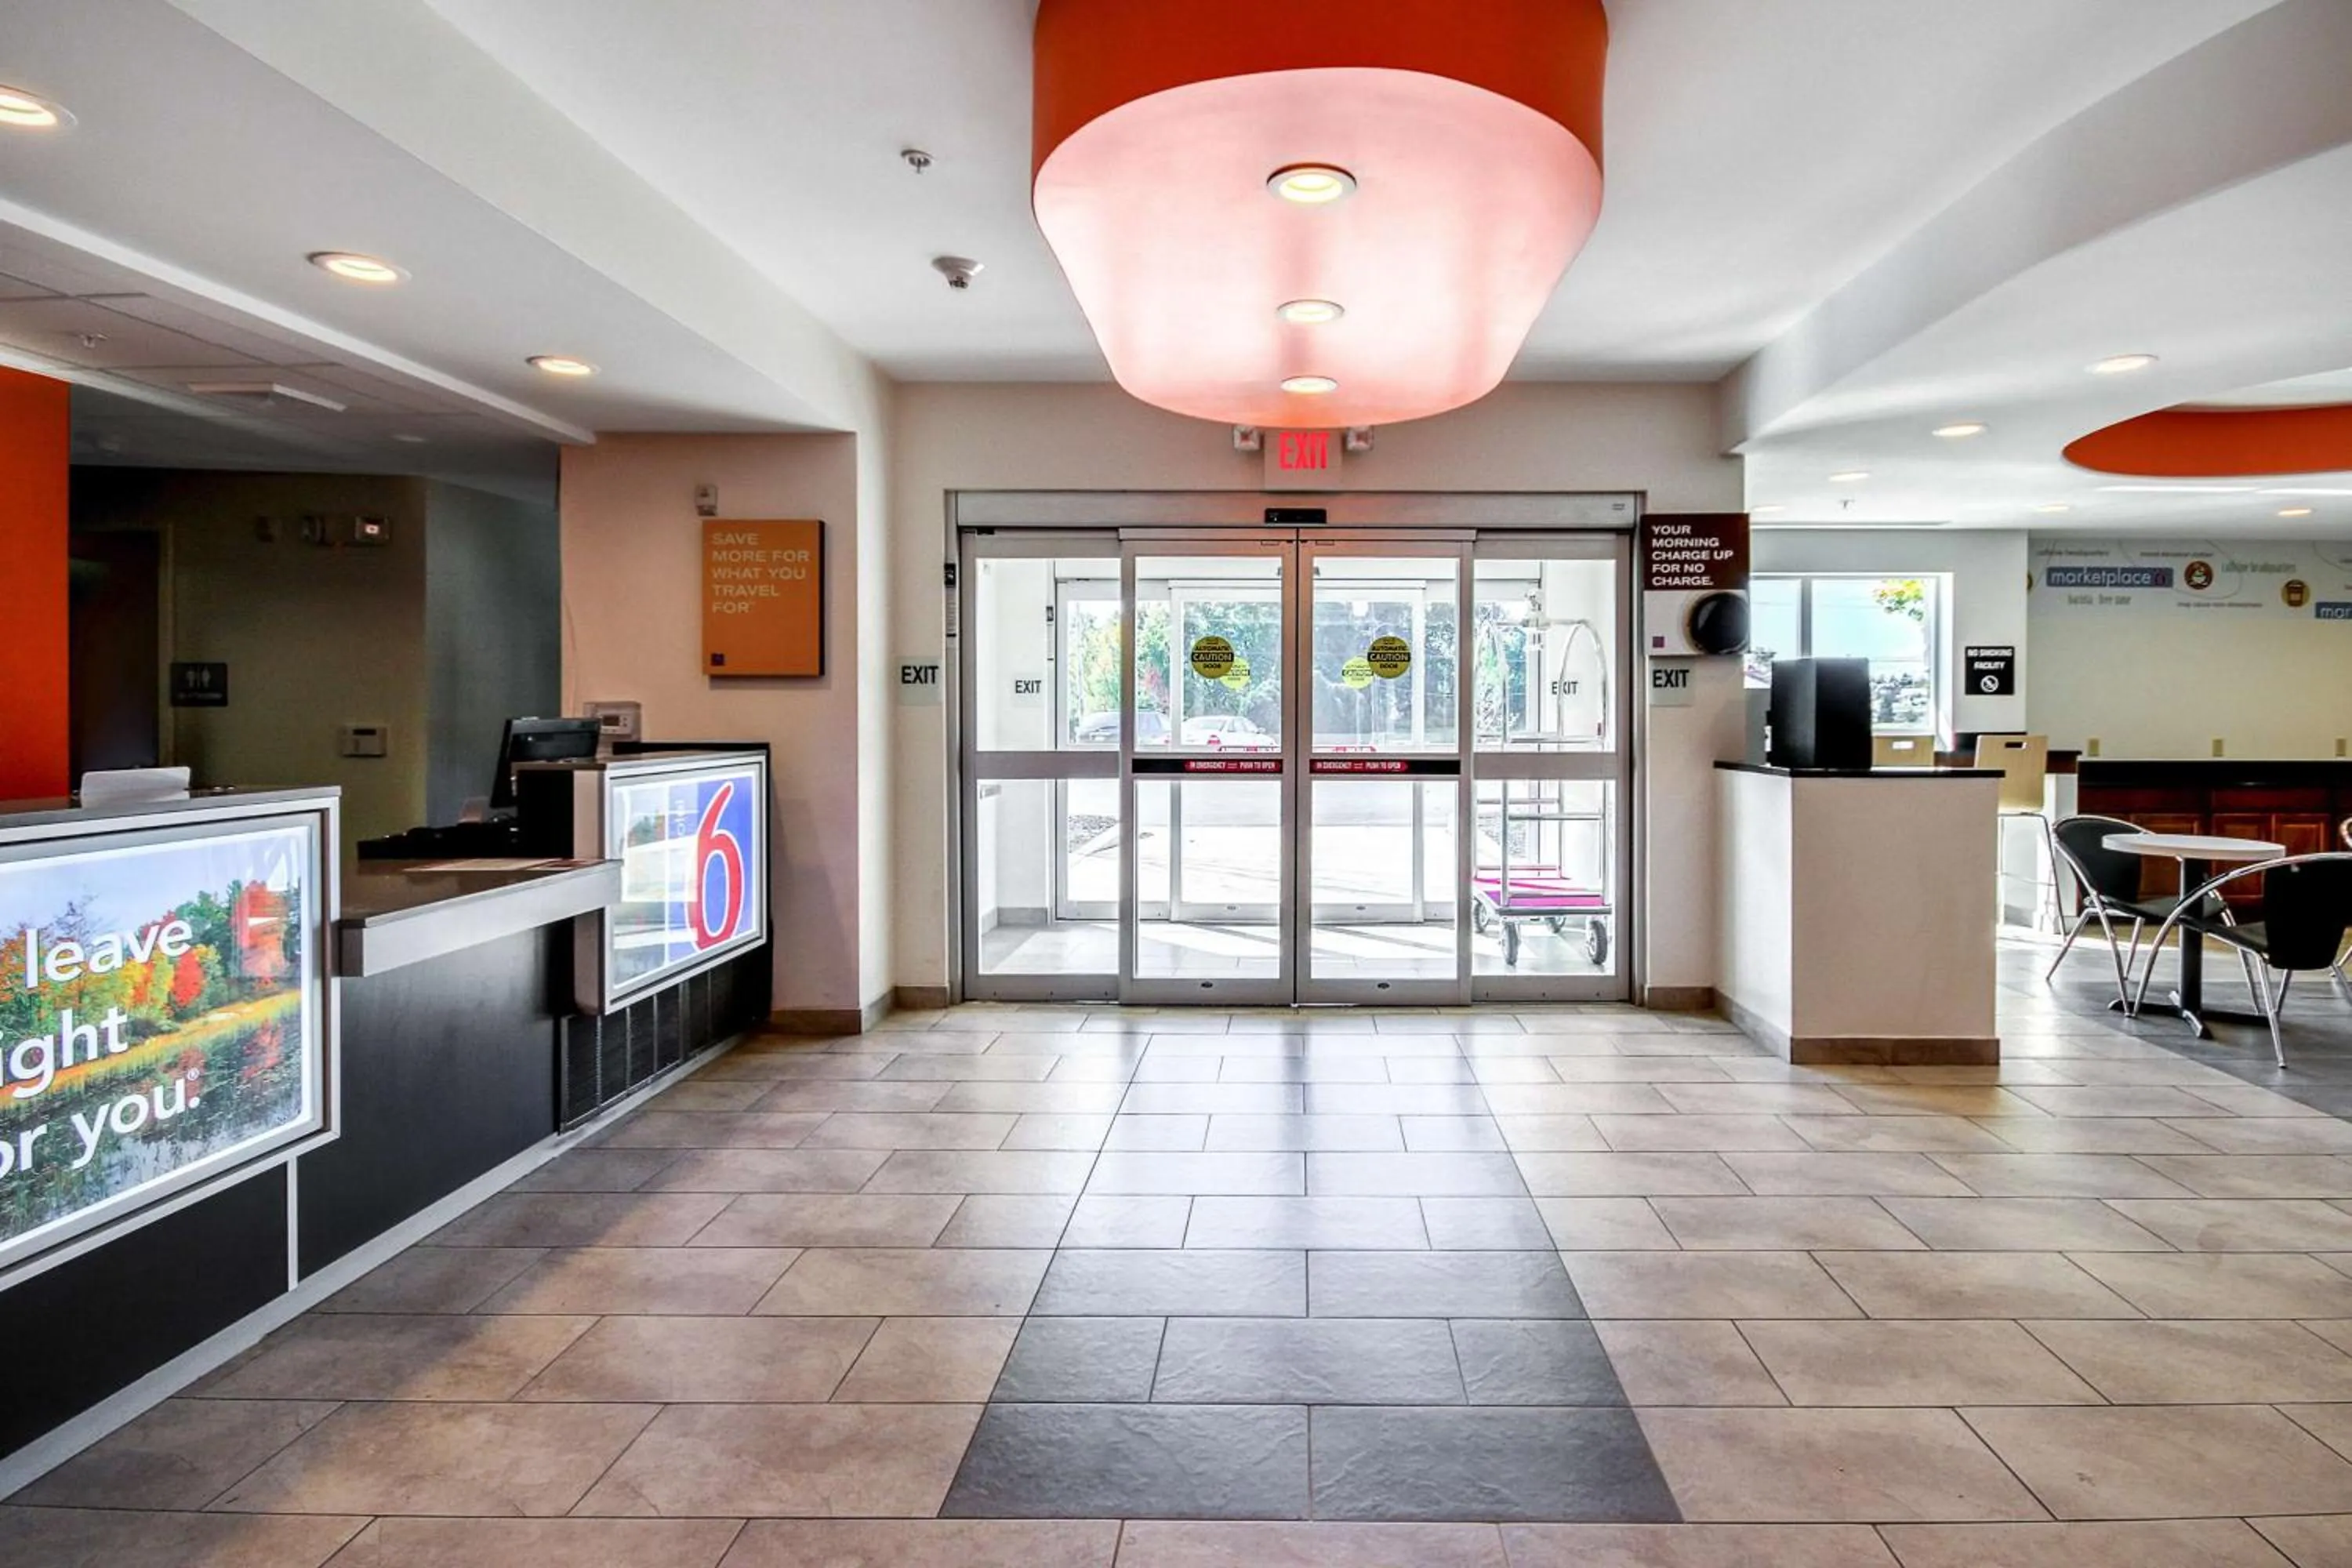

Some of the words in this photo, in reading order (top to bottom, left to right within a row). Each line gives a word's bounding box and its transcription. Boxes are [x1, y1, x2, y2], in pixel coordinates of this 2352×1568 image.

[1279, 431, 1330, 470] EXIT
[1651, 525, 1691, 535] YOUR
[712, 533, 759, 546] SAVE
[1652, 538, 1719, 547] MORNING
[712, 550, 767, 563] MORE
[772, 550, 810, 563] FOR
[1652, 551, 1710, 561] CHARGE
[1713, 550, 1733, 560] UP
[713, 566, 764, 579] WHAT
[768, 566, 807, 580] YOU
[1652, 564, 1680, 573] FOR
[1683, 564, 1705, 573] NO
[1652, 576, 1714, 586] CHARGE.
[2051, 567, 2151, 587] marketplace
[712, 584, 780, 597] TRAVEL
[901, 665, 939, 684] EXIT
[1652, 670, 1689, 688] EXIT
[1015, 680, 1042, 694] EXIT
[684, 781, 744, 952] 6
[25, 918, 193, 989] leave
